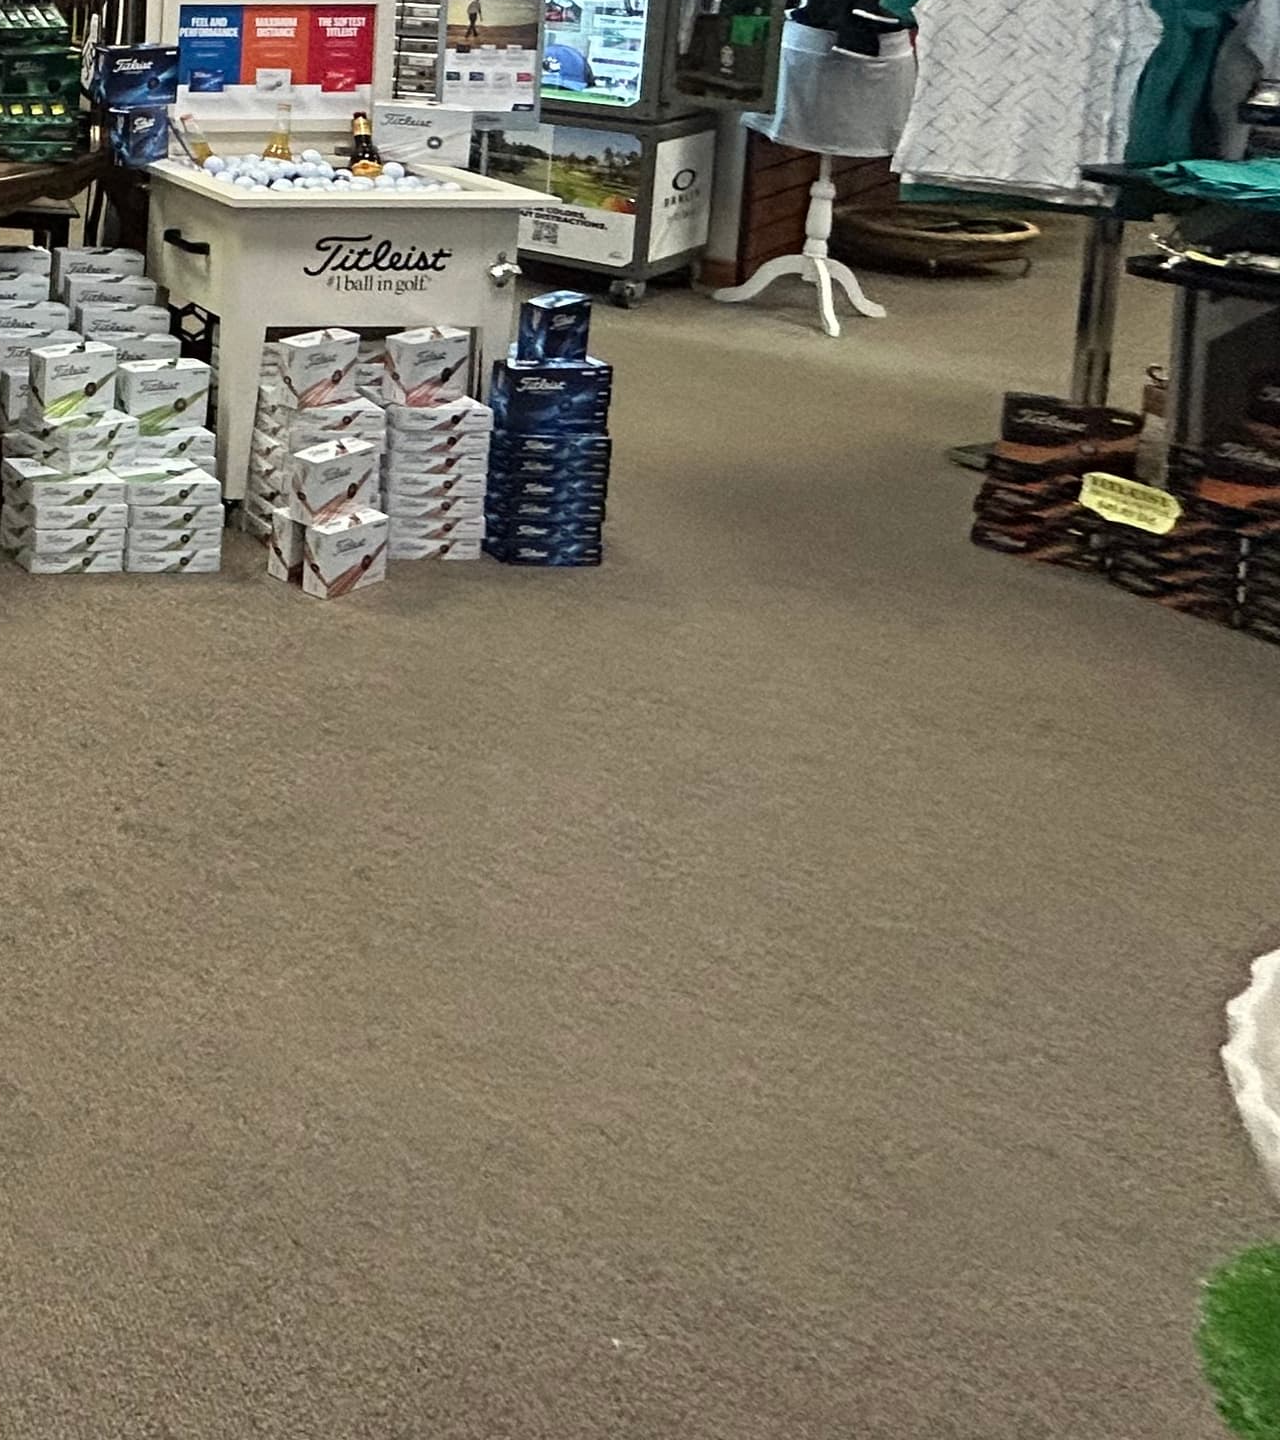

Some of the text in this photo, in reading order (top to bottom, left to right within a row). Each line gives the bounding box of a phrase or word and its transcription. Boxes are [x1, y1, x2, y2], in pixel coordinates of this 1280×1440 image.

[379, 112, 433, 128] Titleist
[303, 234, 453, 276] Titleist
[344, 274, 374, 292] ball
[377, 275, 393, 291] in
